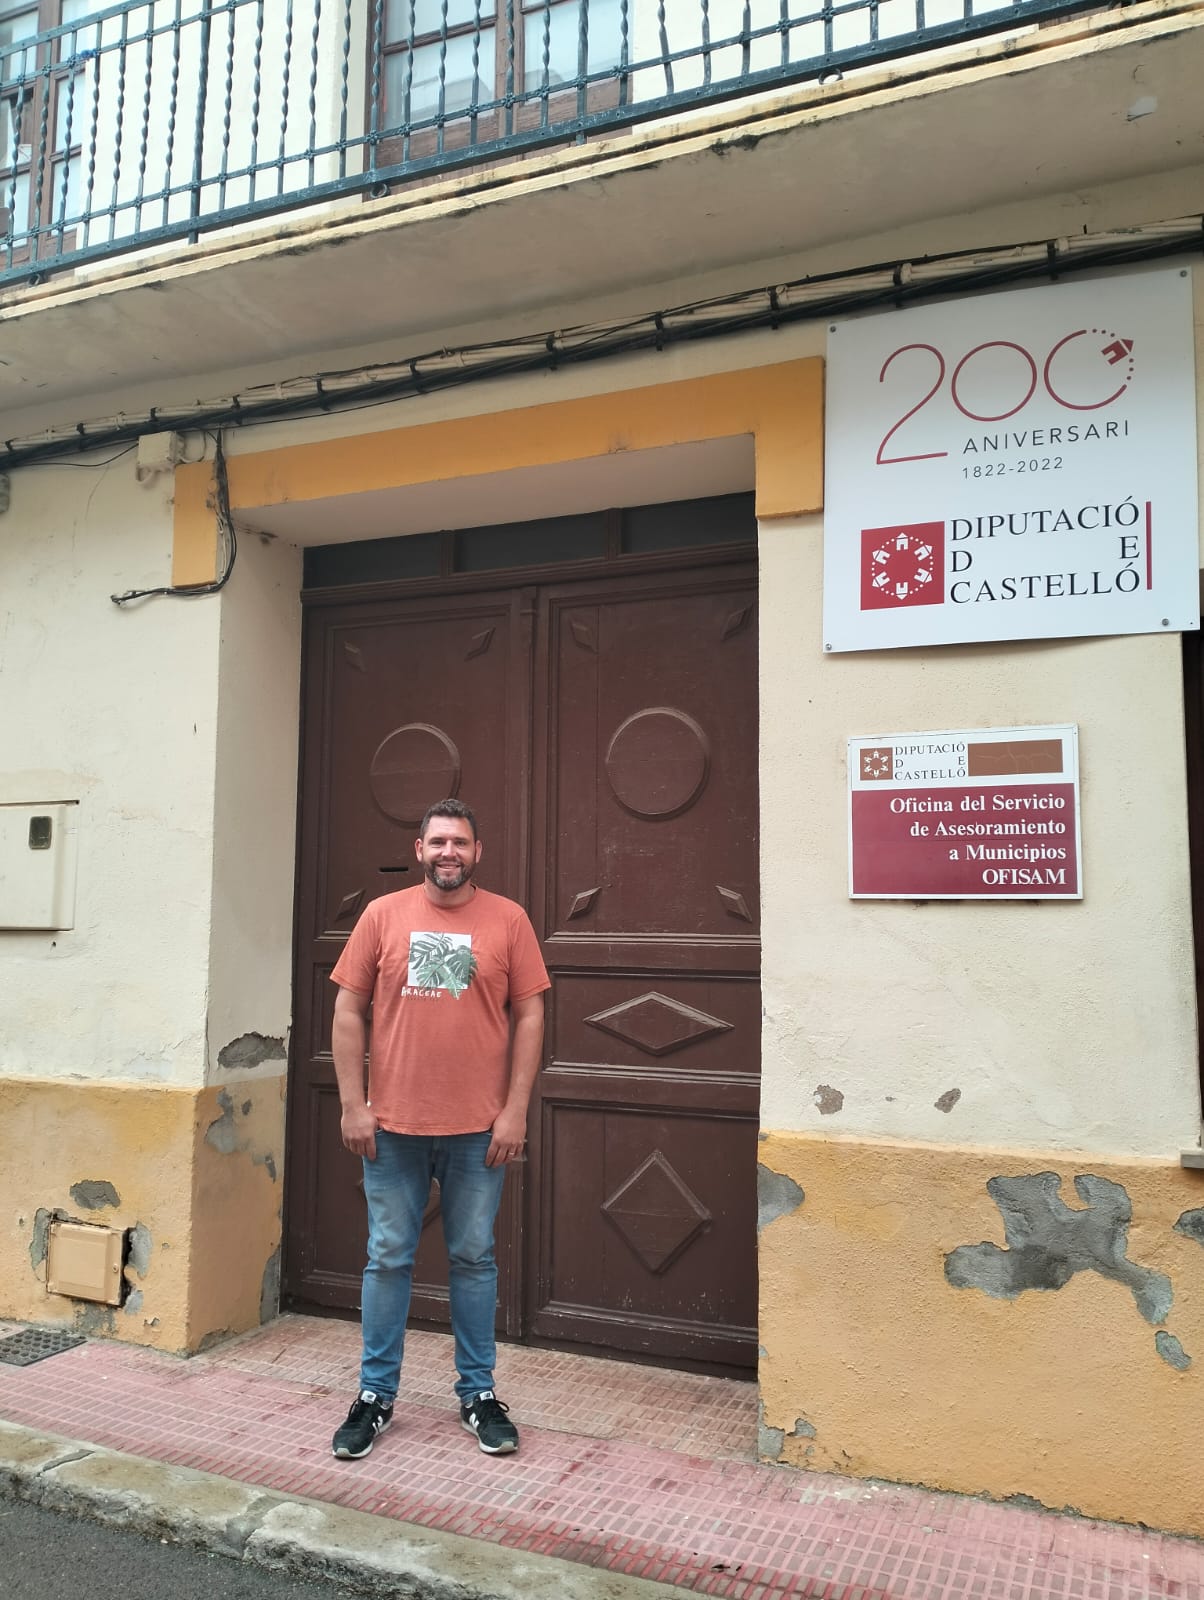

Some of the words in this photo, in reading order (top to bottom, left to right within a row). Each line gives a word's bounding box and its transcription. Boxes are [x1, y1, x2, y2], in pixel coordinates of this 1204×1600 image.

[962, 419, 1130, 455] ANIVERSARI
[961, 456, 1064, 479] 1822-2022
[950, 495, 1140, 542] DIPUTACIÓ
[950, 550, 973, 573] D
[1119, 536, 1140, 560] E
[949, 562, 1140, 605] CASTELLÓ
[895, 740, 966, 756] DIPUTACIÓ
[894, 766, 966, 781] CASTELLÓ
[889, 796, 953, 814] Oficina
[960, 795, 986, 811] del
[992, 793, 1066, 811] Servicio
[910, 821, 930, 837] de
[934, 818, 1066, 837] Asesoramiento
[949, 848, 959, 861] a
[965, 843, 1067, 863] Municipios
[982, 868, 1066, 885] OFISAM
